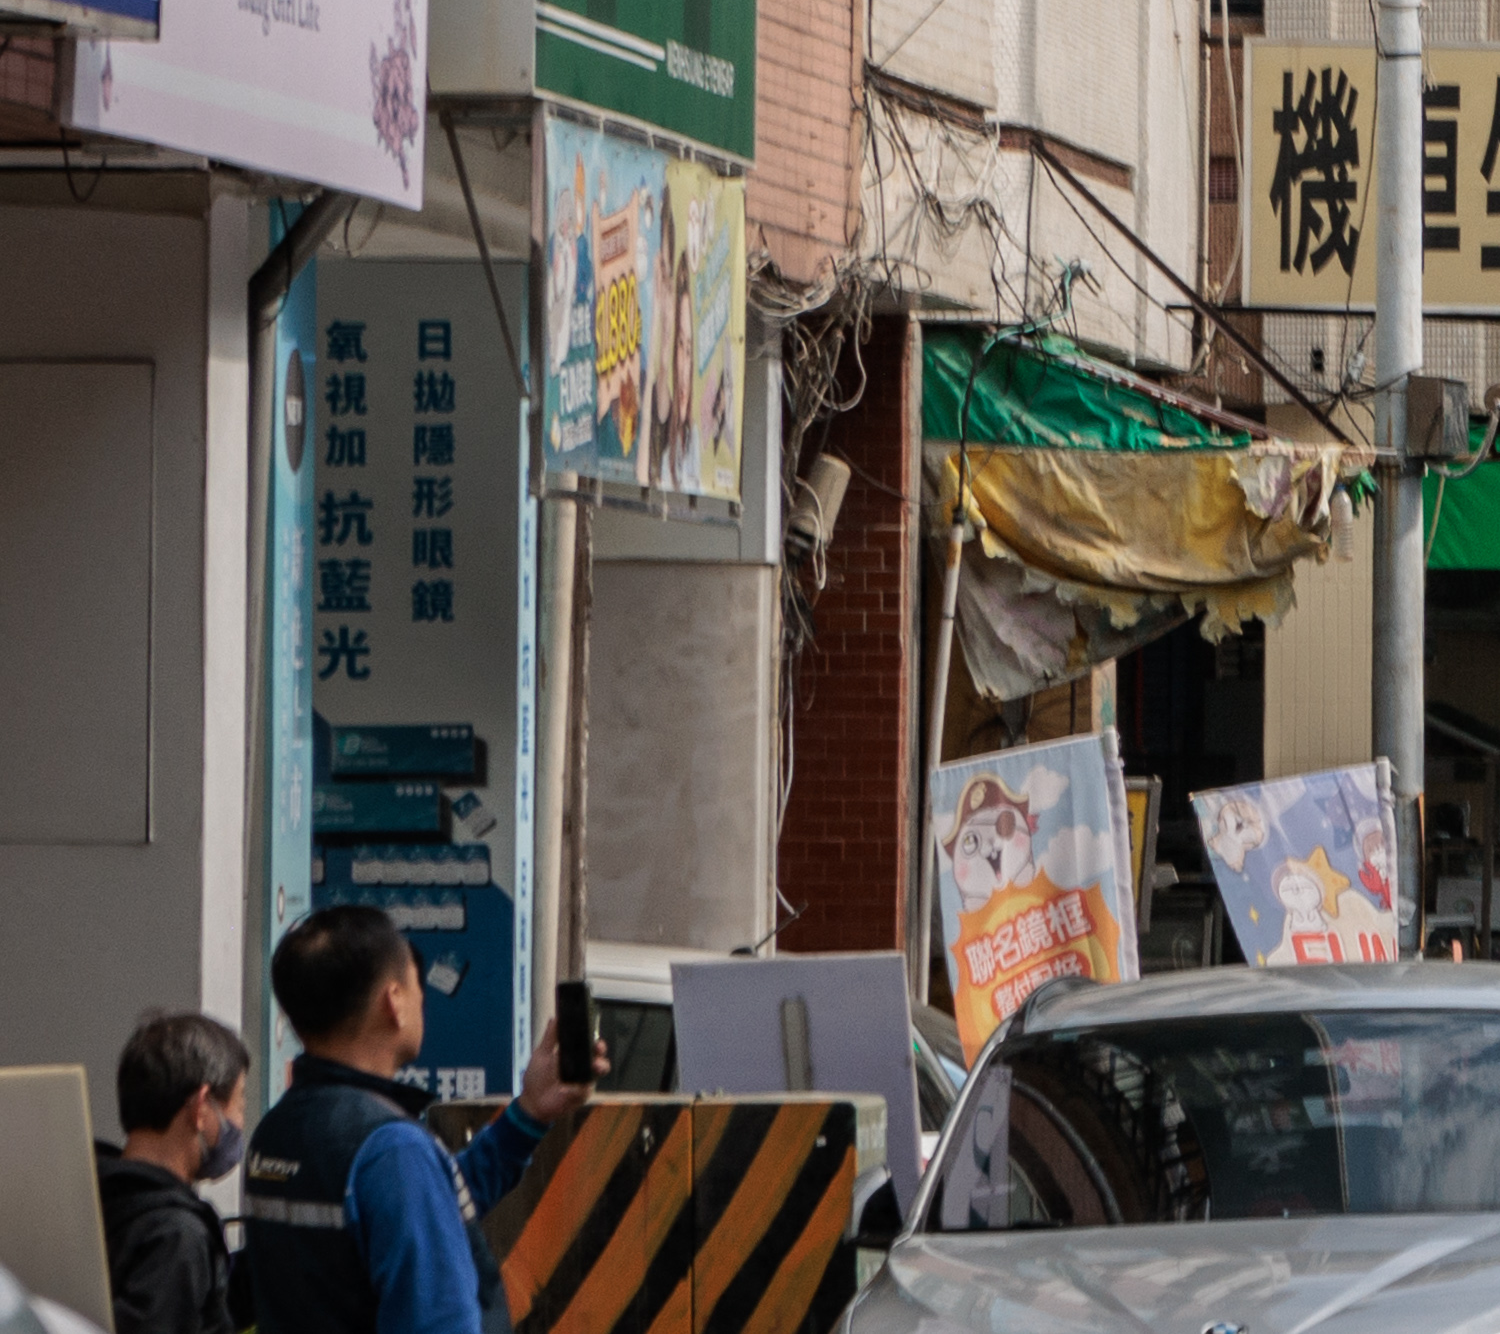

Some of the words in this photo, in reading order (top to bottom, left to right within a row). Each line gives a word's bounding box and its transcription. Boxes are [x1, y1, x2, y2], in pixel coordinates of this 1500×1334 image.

[317, 490, 373, 681] 抗藍光
[965, 891, 1093, 985] 聯名鏡框
